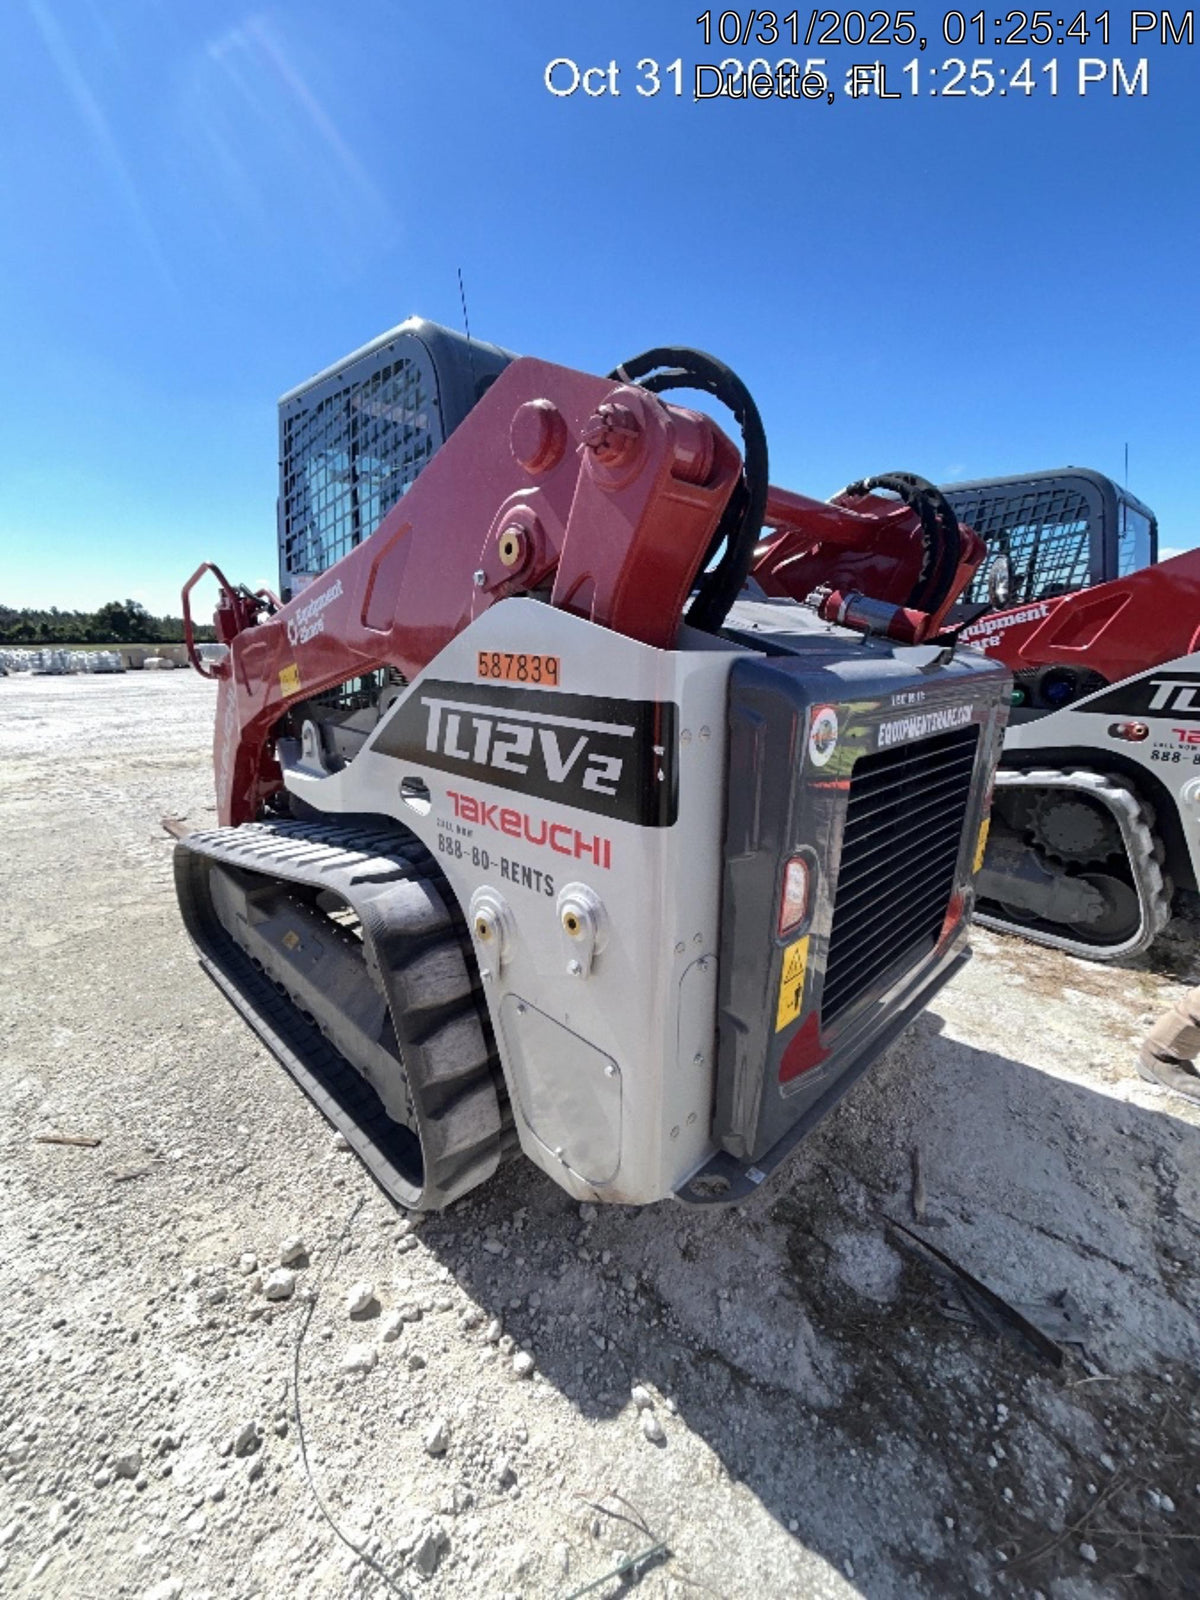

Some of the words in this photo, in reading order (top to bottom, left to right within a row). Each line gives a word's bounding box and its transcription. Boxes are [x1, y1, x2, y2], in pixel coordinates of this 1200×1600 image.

[958, 604, 1050, 641] quipment
[479, 652, 557, 686] 587839
[421, 696, 636, 796] TL12V2
[438, 833, 555, 897] 888-80-RENTS
